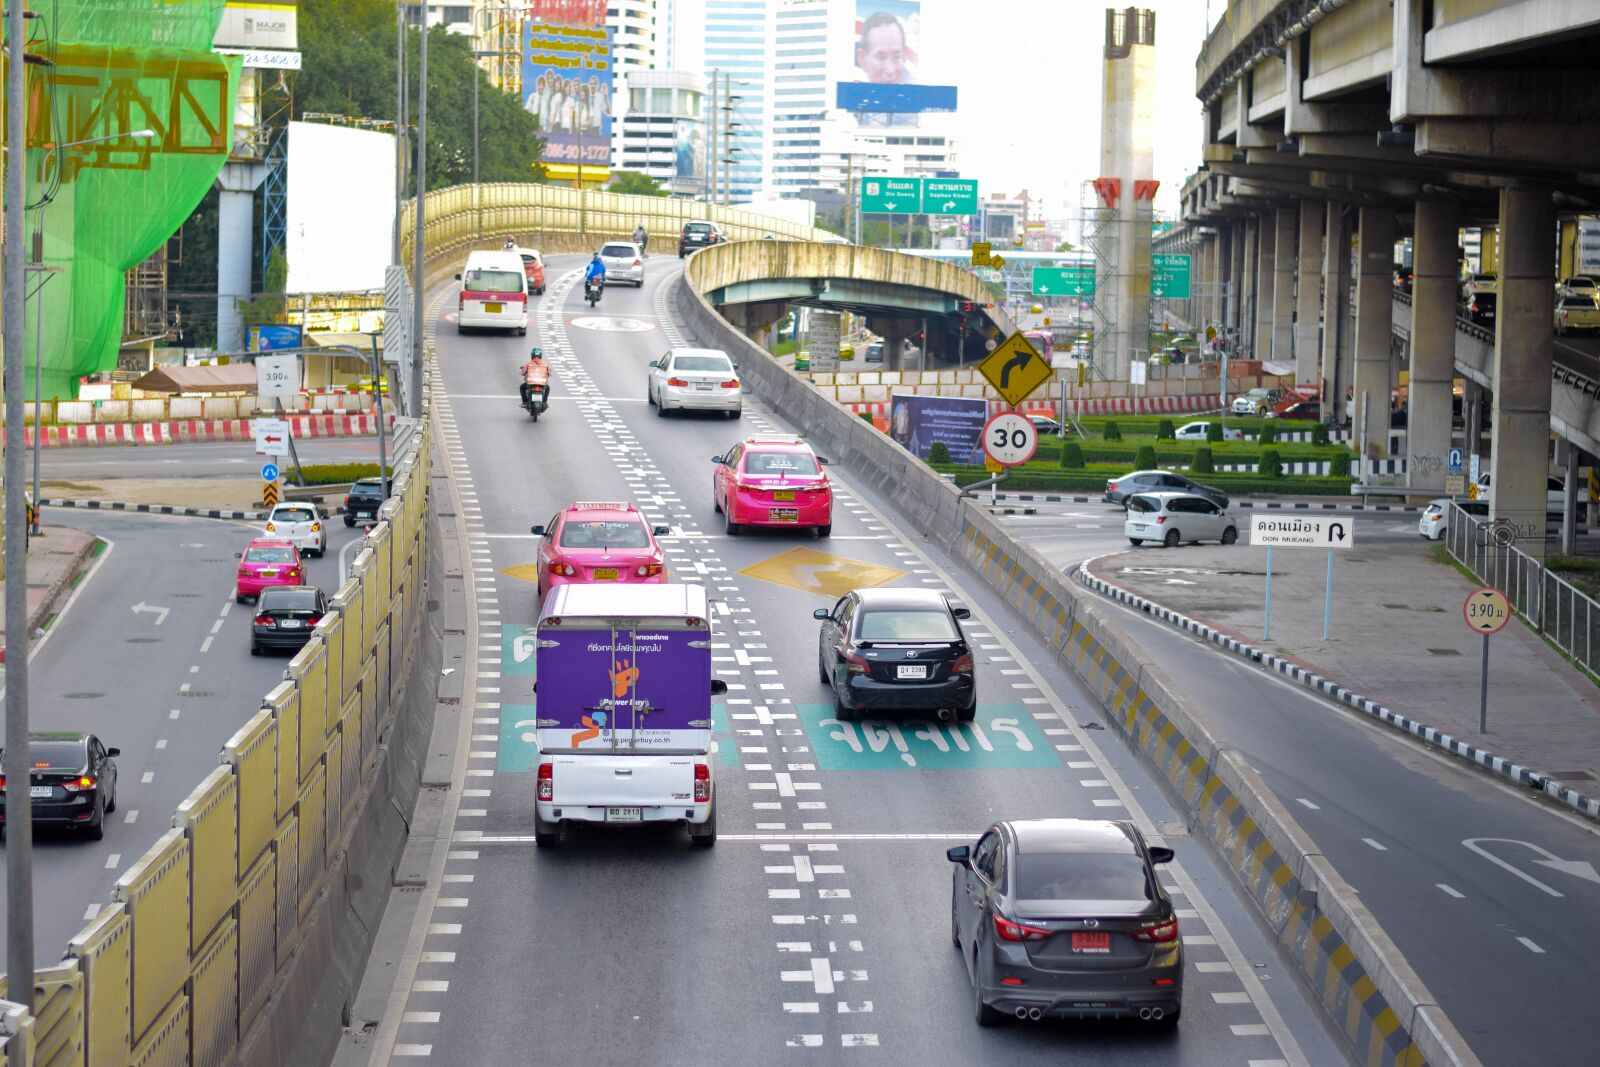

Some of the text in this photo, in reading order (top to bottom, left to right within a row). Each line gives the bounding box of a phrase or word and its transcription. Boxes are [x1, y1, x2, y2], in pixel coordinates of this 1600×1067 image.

[992, 428, 1027, 449] 30
[1258, 518, 1320, 533] ดอนเมือง
[1470, 603, 1494, 618] 3.90
[634, 633, 669, 641] พาเวอร์บาย
[818, 717, 1034, 767] จตุจกร
